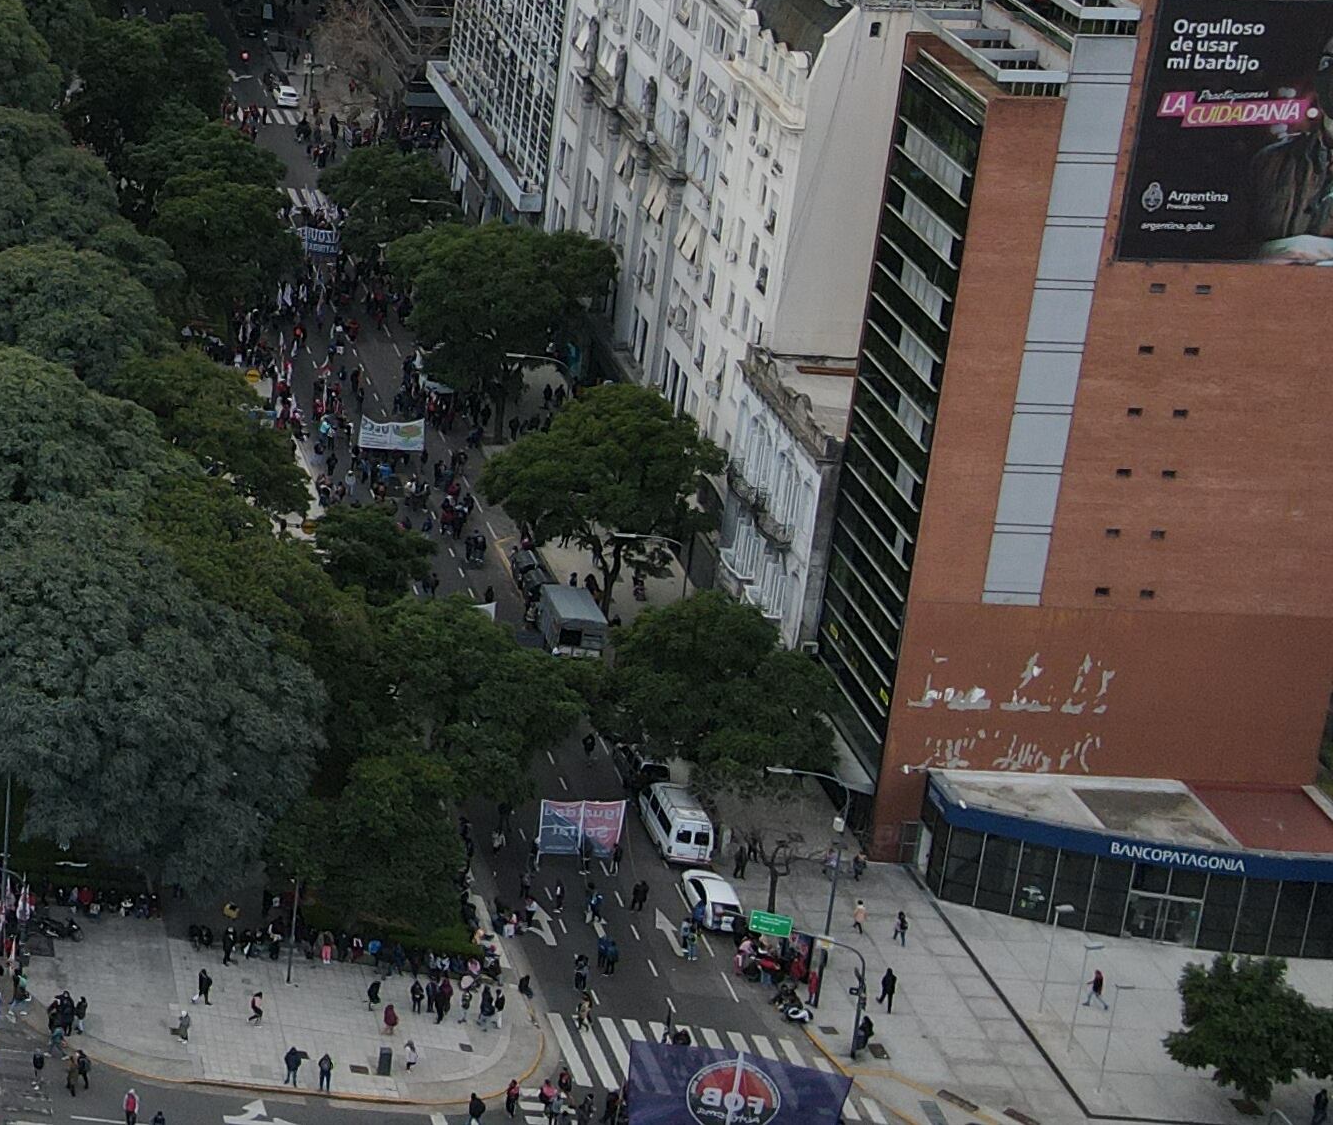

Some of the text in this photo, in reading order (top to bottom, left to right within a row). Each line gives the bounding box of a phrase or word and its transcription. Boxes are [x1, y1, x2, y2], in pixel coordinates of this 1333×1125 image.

[1173, 19, 1266, 38] Orgulloso
[1170, 37, 1238, 53] de usar
[1167, 53, 1260, 74] mi barbijo
[1161, 95, 1186, 114] LA
[1186, 100, 1300, 124] CUIDADANÍA
[1168, 190, 1229, 204] Argentina
[1111, 841, 1245, 872] BANCOPATAGONIA
